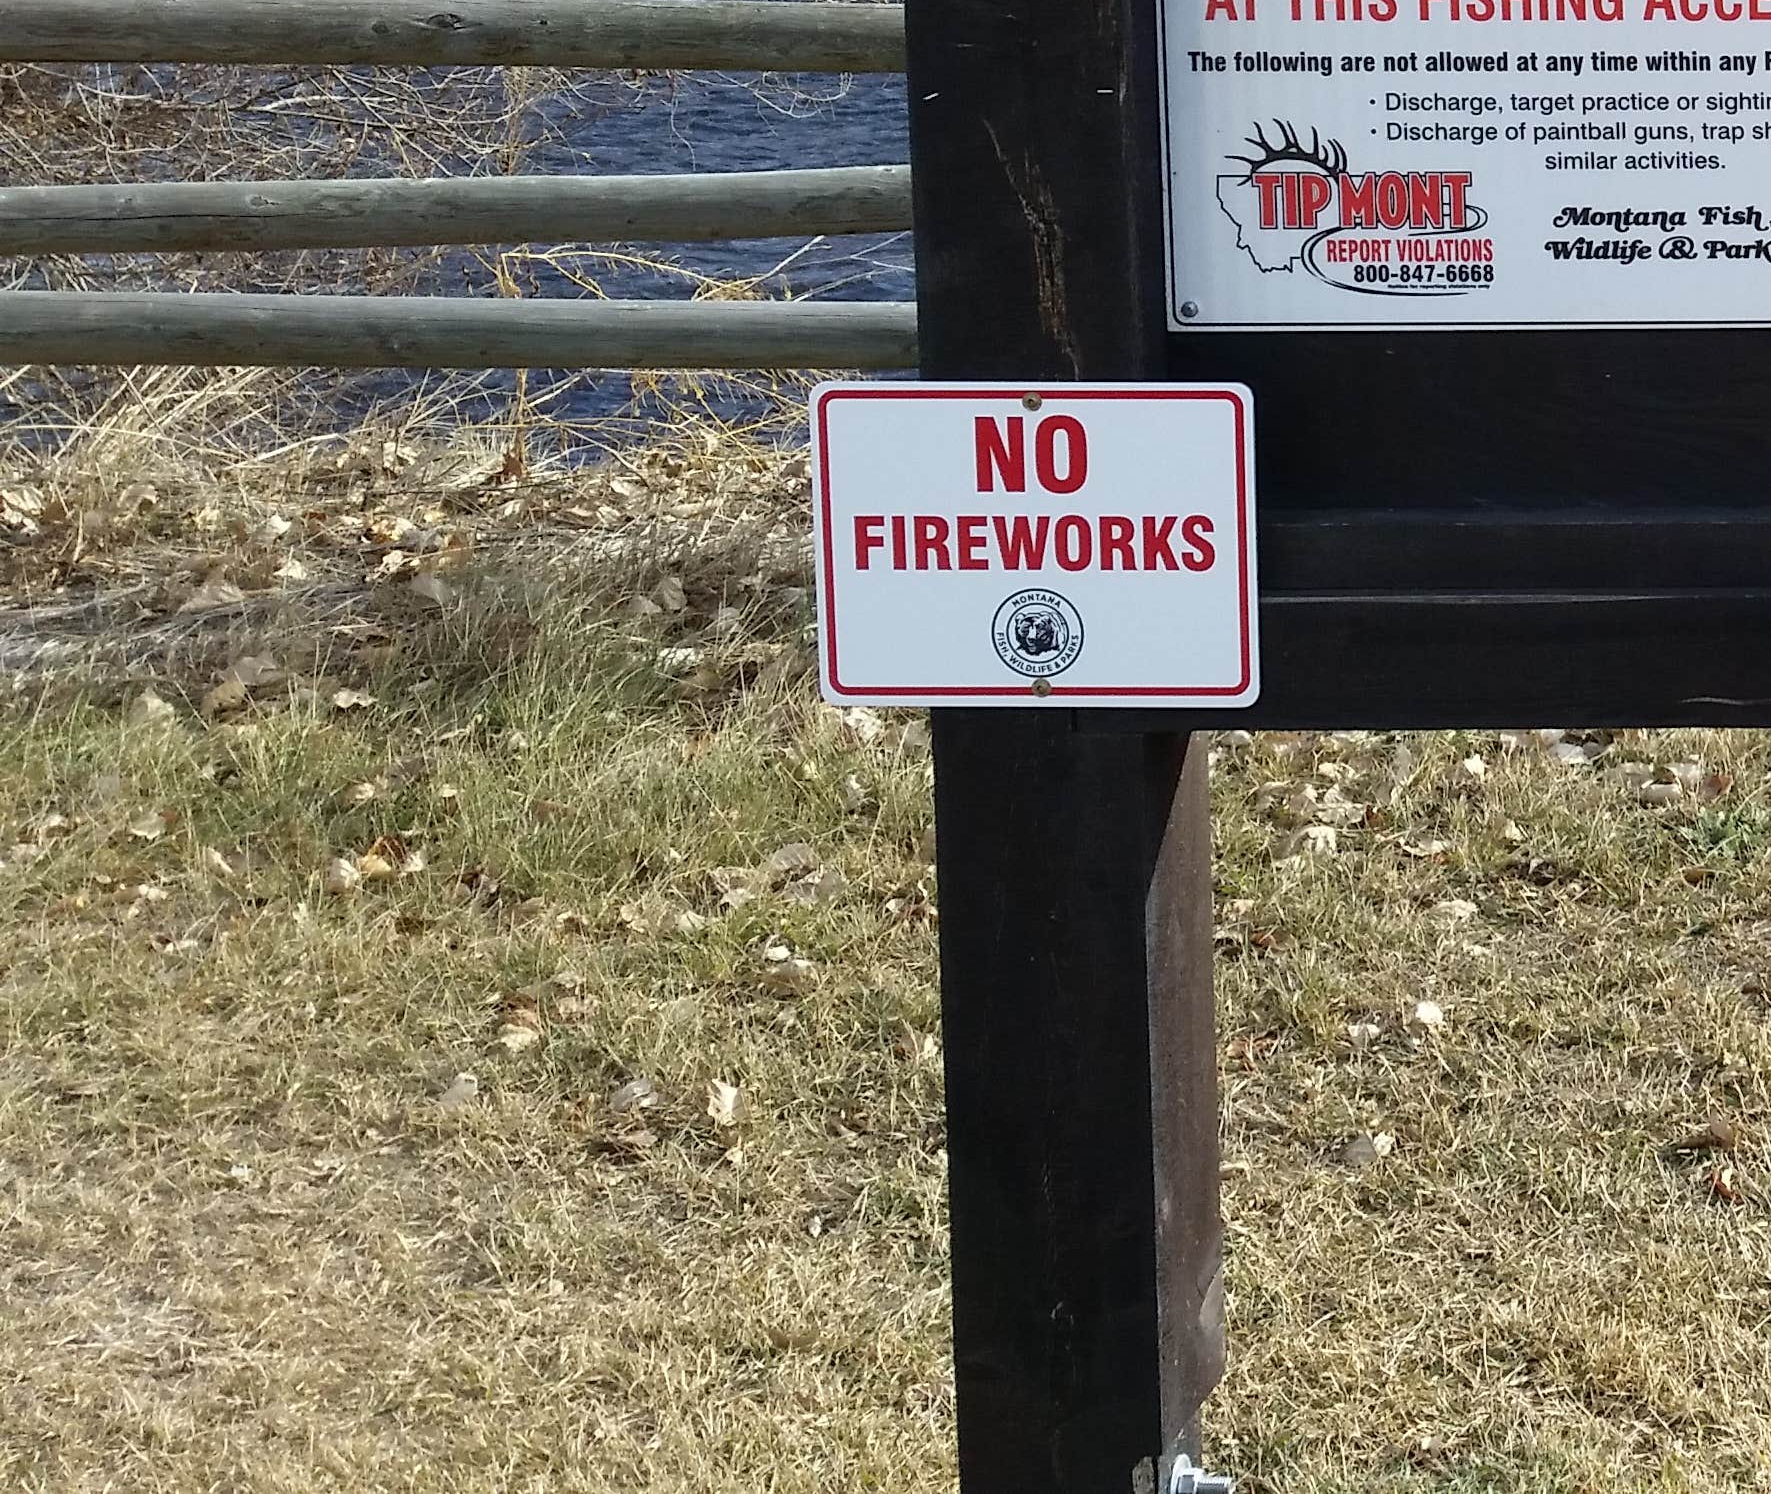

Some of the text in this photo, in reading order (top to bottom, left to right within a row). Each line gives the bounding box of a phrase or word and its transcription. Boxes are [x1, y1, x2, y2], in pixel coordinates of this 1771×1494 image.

[1187, 51, 1227, 72] The
[1233, 51, 1333, 77] following
[1340, 56, 1376, 72] are
[1383, 52, 1419, 72] not
[1425, 51, 1509, 72] allowed
[1516, 52, 1539, 72] at
[1545, 55, 1584, 77] any
[1590, 50, 1638, 72] time
[1645, 50, 1711, 72] within
[1718, 55, 1757, 76] any
[1385, 92, 1503, 116] Discharge,
[1509, 93, 1575, 116] target
[1582, 92, 1670, 116] practice
[1676, 96, 1700, 111] or
[1545, 151, 1726, 170] similar activities.
[1252, 171, 1473, 230] TIP MONT
[1552, 206, 1687, 233] Montana
[1326, 238, 1493, 263] REPORT VIOLATIONS
[1544, 236, 1652, 265] Wildlife
[1658, 235, 1698, 260] &
[1353, 264, 1495, 283] 800-847-6668
[974, 414, 1088, 495] NO
[853, 514, 1216, 572] FIREWORKS
